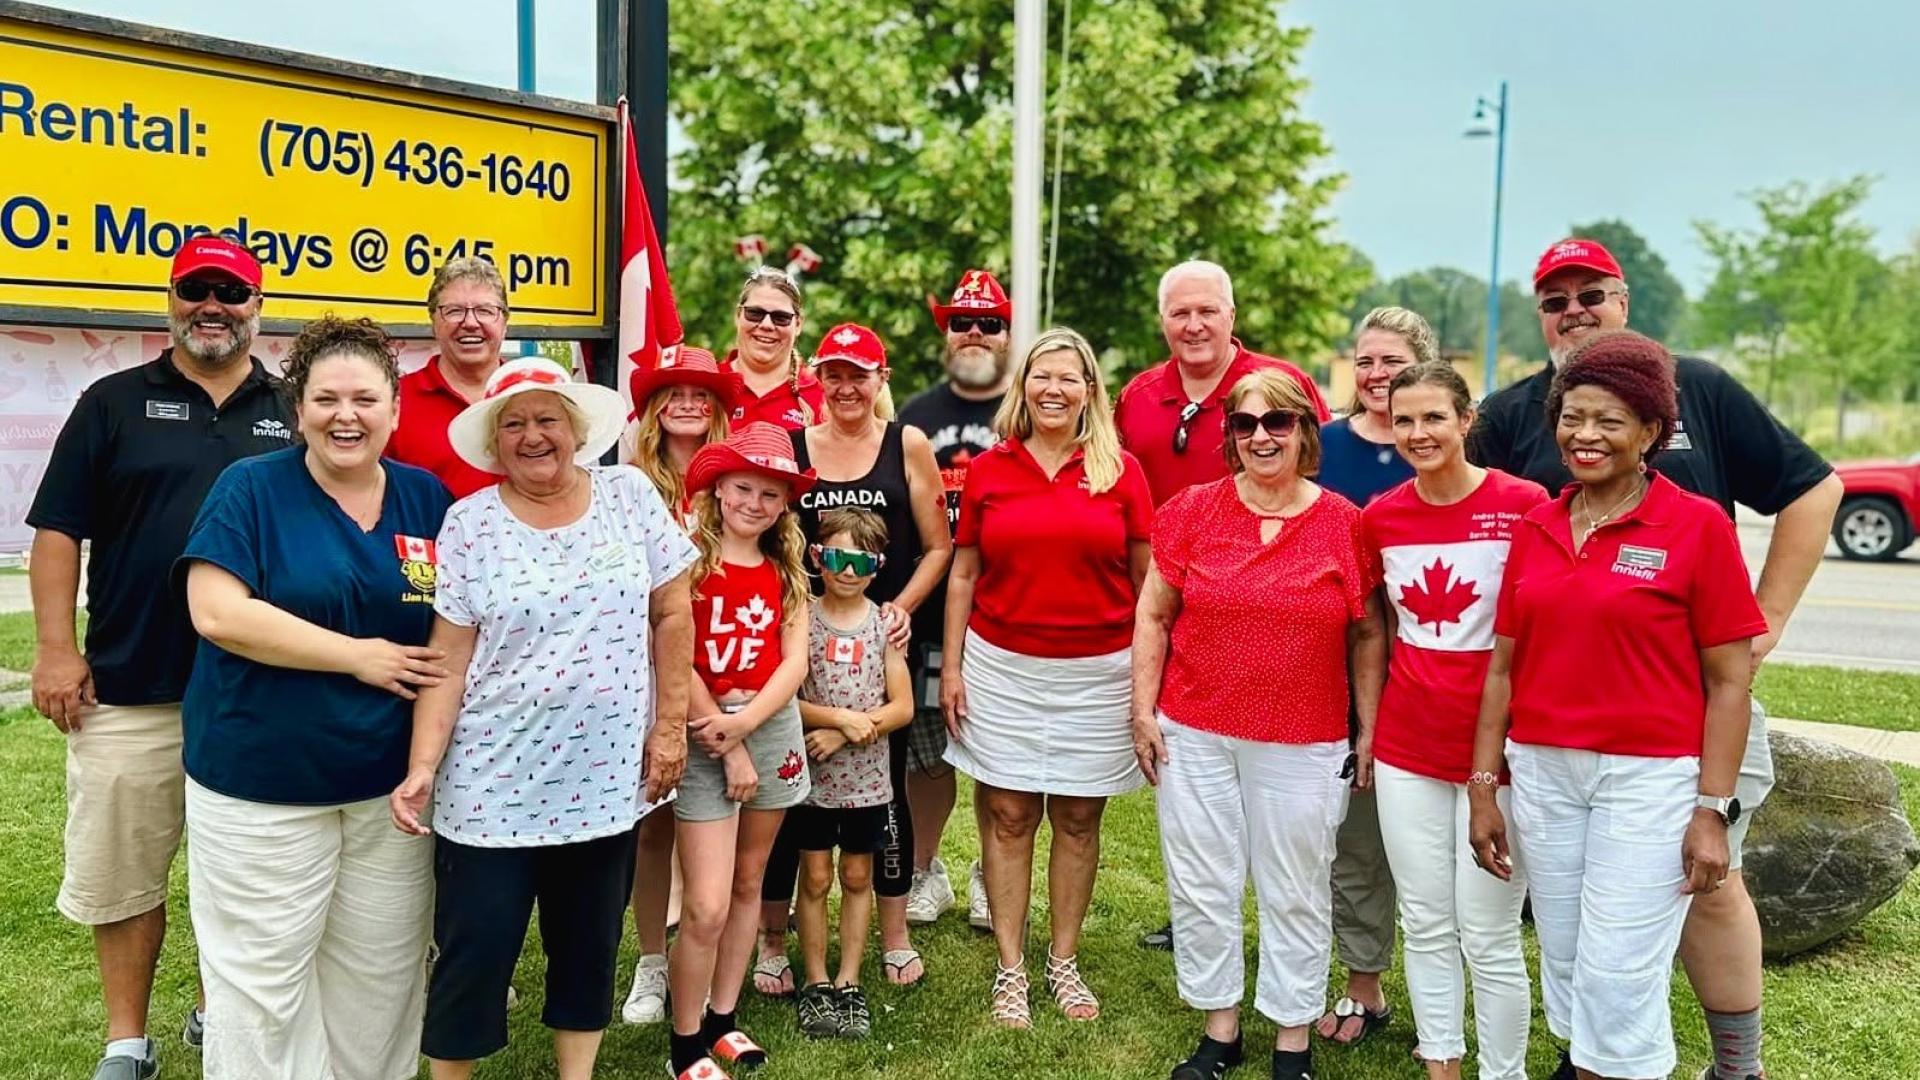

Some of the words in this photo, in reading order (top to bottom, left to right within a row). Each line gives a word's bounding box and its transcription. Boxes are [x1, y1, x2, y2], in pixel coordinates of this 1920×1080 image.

[0, 82, 206, 157] Rental:
[260, 119, 375, 187] (705)
[384, 139, 570, 202] 436-1640
[350, 228, 388, 272] @
[509, 252, 570, 291] pm
[800, 489, 888, 508] CANADA
[704, 637, 765, 673] VE
